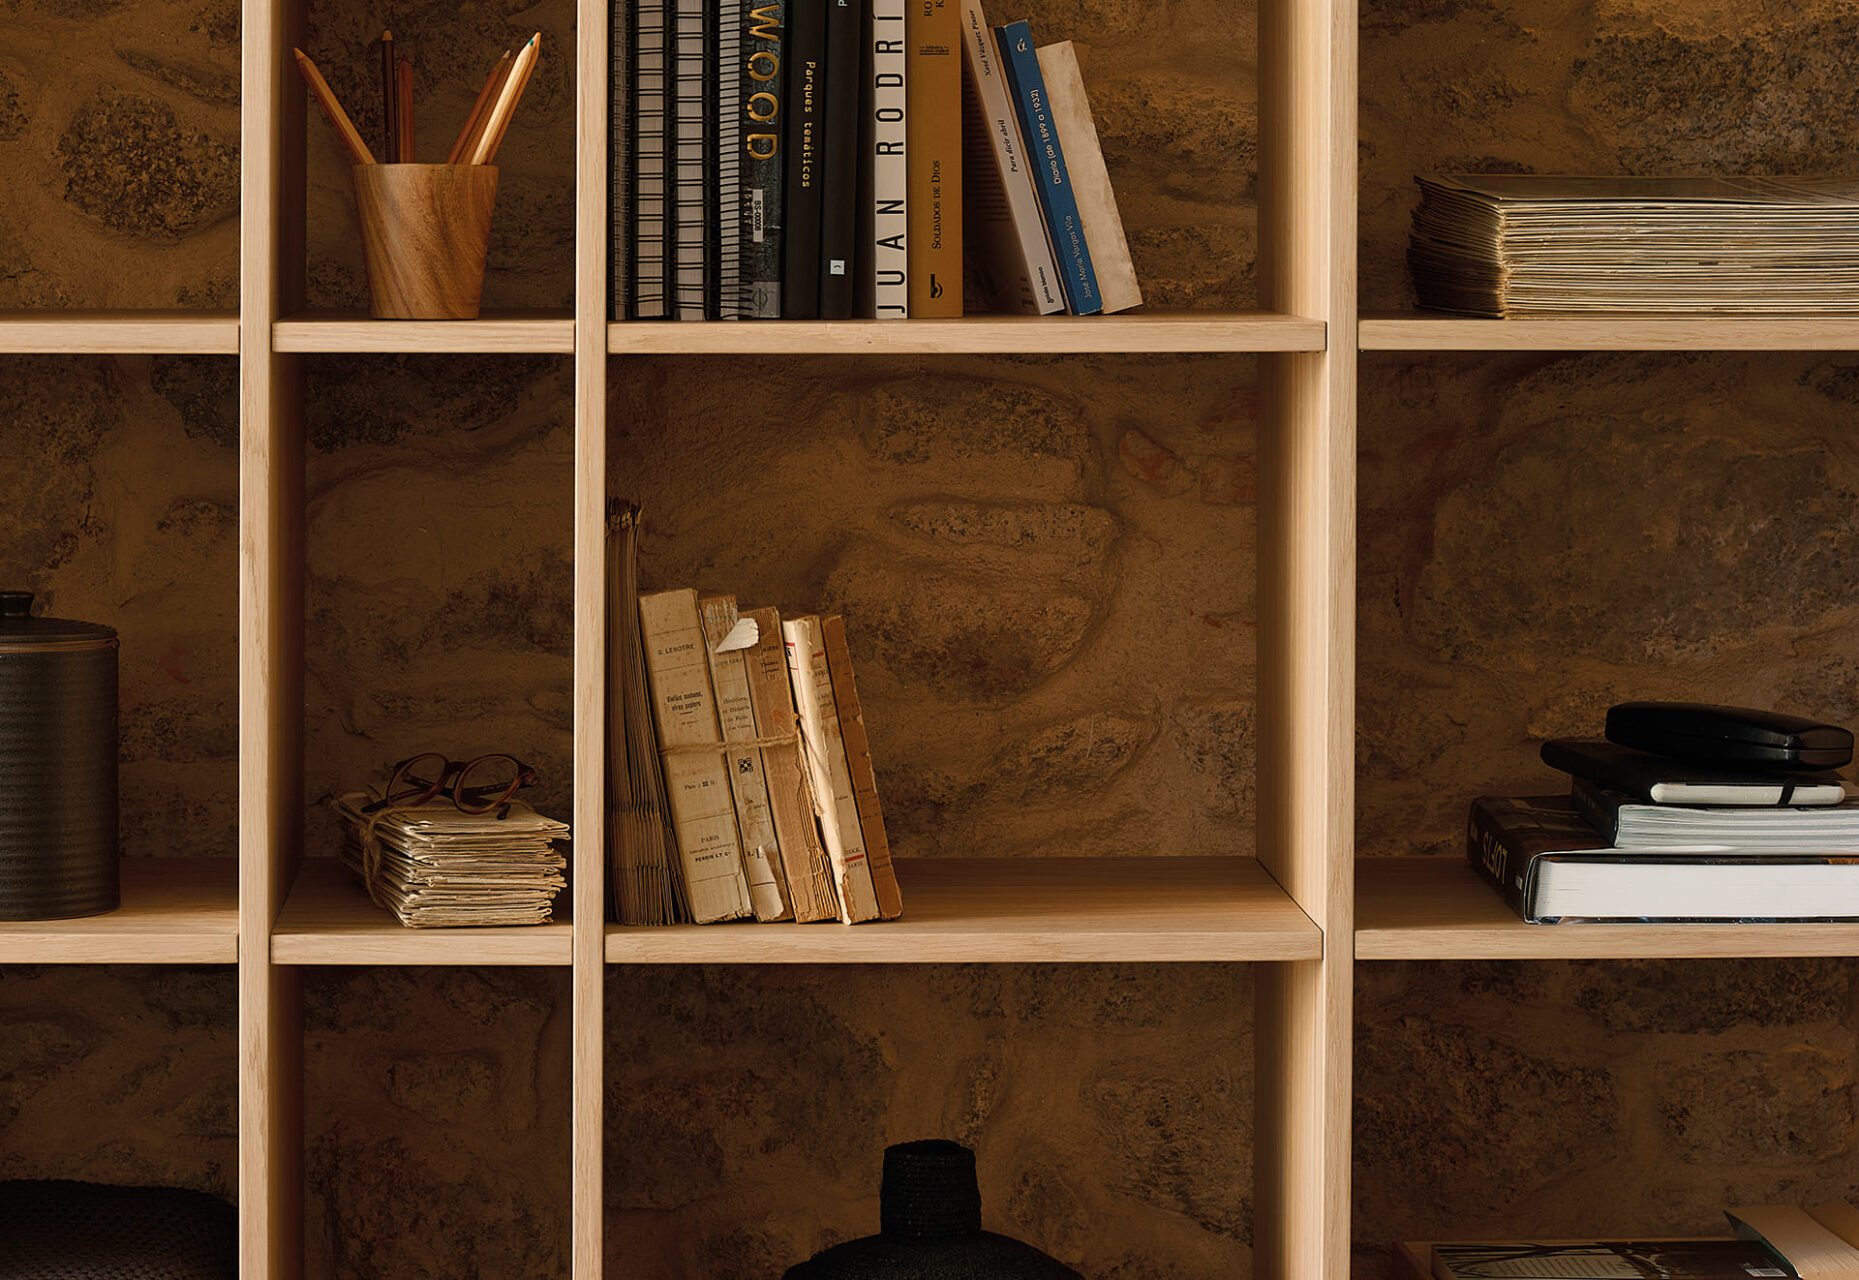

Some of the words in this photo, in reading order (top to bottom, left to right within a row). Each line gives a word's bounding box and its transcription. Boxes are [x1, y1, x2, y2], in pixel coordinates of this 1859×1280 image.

[747, 3, 780, 160] WOOD
[802, 61, 816, 113] Parques
[1030, 89, 1042, 112] 1932)
[997, 120, 1008, 137] abril
[1039, 123, 1050, 143] 1899
[802, 122, 814, 188] temáticos
[1009, 156, 1018, 173] Para
[1050, 161, 1062, 185] Diario
[876, 200, 906, 314] JUAN
[1481, 831, 1508, 885] LOFTS
